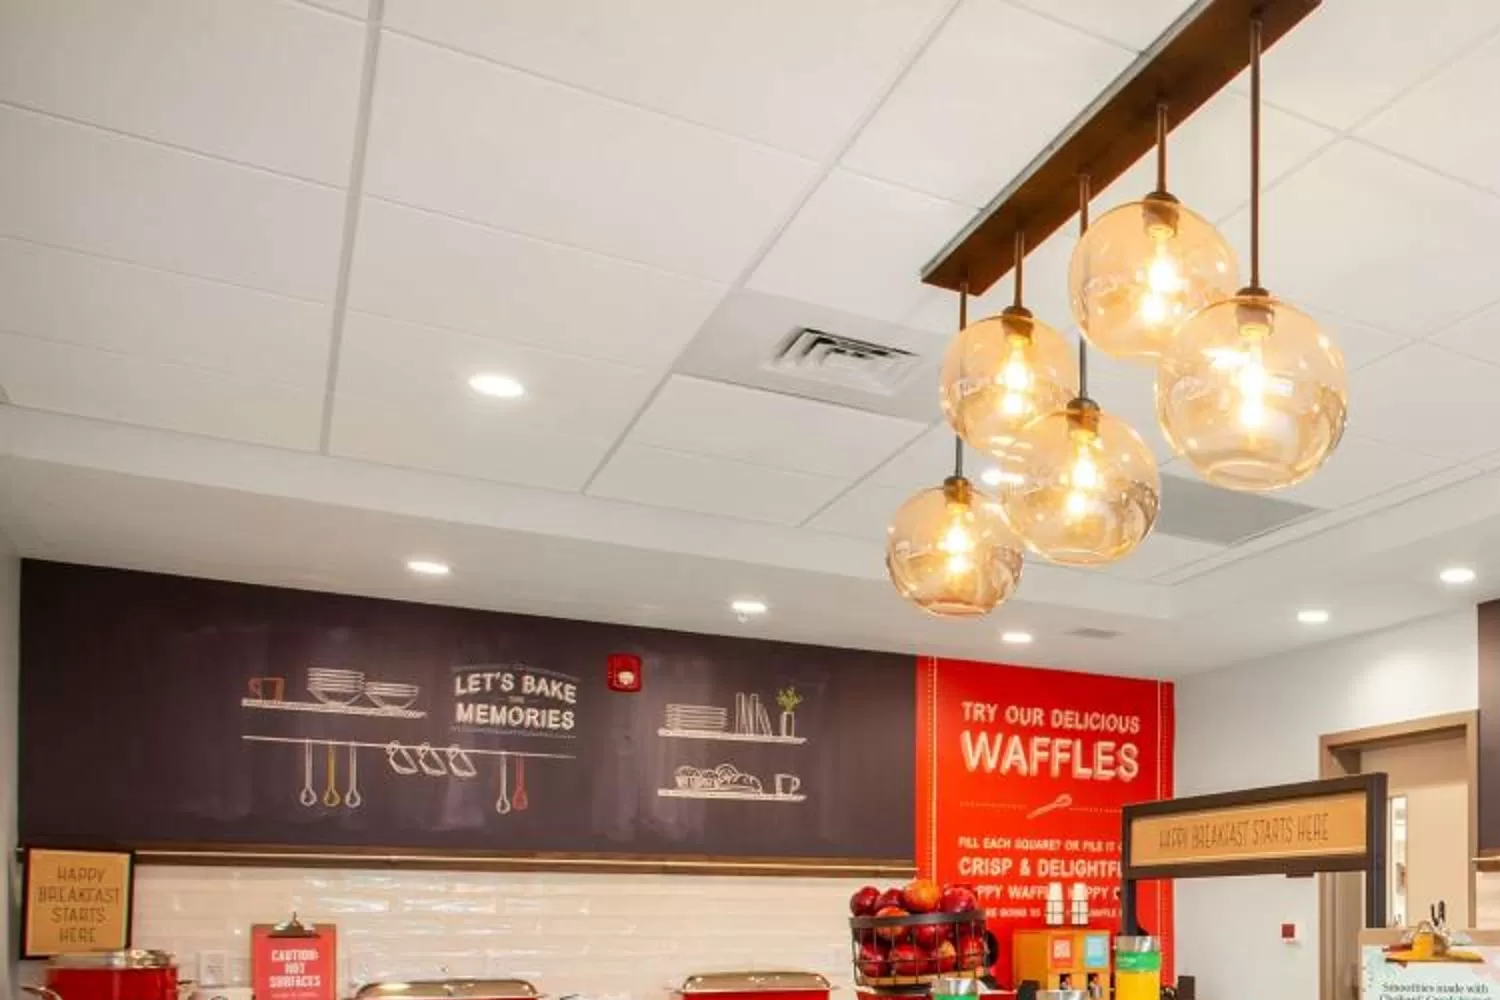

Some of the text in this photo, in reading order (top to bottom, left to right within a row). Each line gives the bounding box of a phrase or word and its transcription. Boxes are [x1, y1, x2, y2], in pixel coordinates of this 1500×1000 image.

[455, 671, 577, 704] LET'S BAKE
[456, 702, 575, 730] MEMORIES
[961, 701, 1141, 734] TRY OUR DELICIOUS
[960, 730, 1139, 782] WAFFLES
[1191, 819, 1249, 848] BREAKFAST
[1252, 815, 1293, 846] STARTS
[1297, 812, 1329, 842] HERE
[958, 835, 979, 849] FILL
[983, 837, 1011, 849] EACH
[1014, 838, 1061, 850] SQUARE?
[1065, 840, 1079, 851] OR
[57, 867, 107, 884] HAPPY
[958, 856, 1122, 878] CRISP & DELIGHTF
[39, 886, 120, 904] BREAKFAST
[51, 907, 106, 924] STARTS
[59, 927, 97, 943] HERE
[1381, 982, 1489, 993] Smoothies made with
